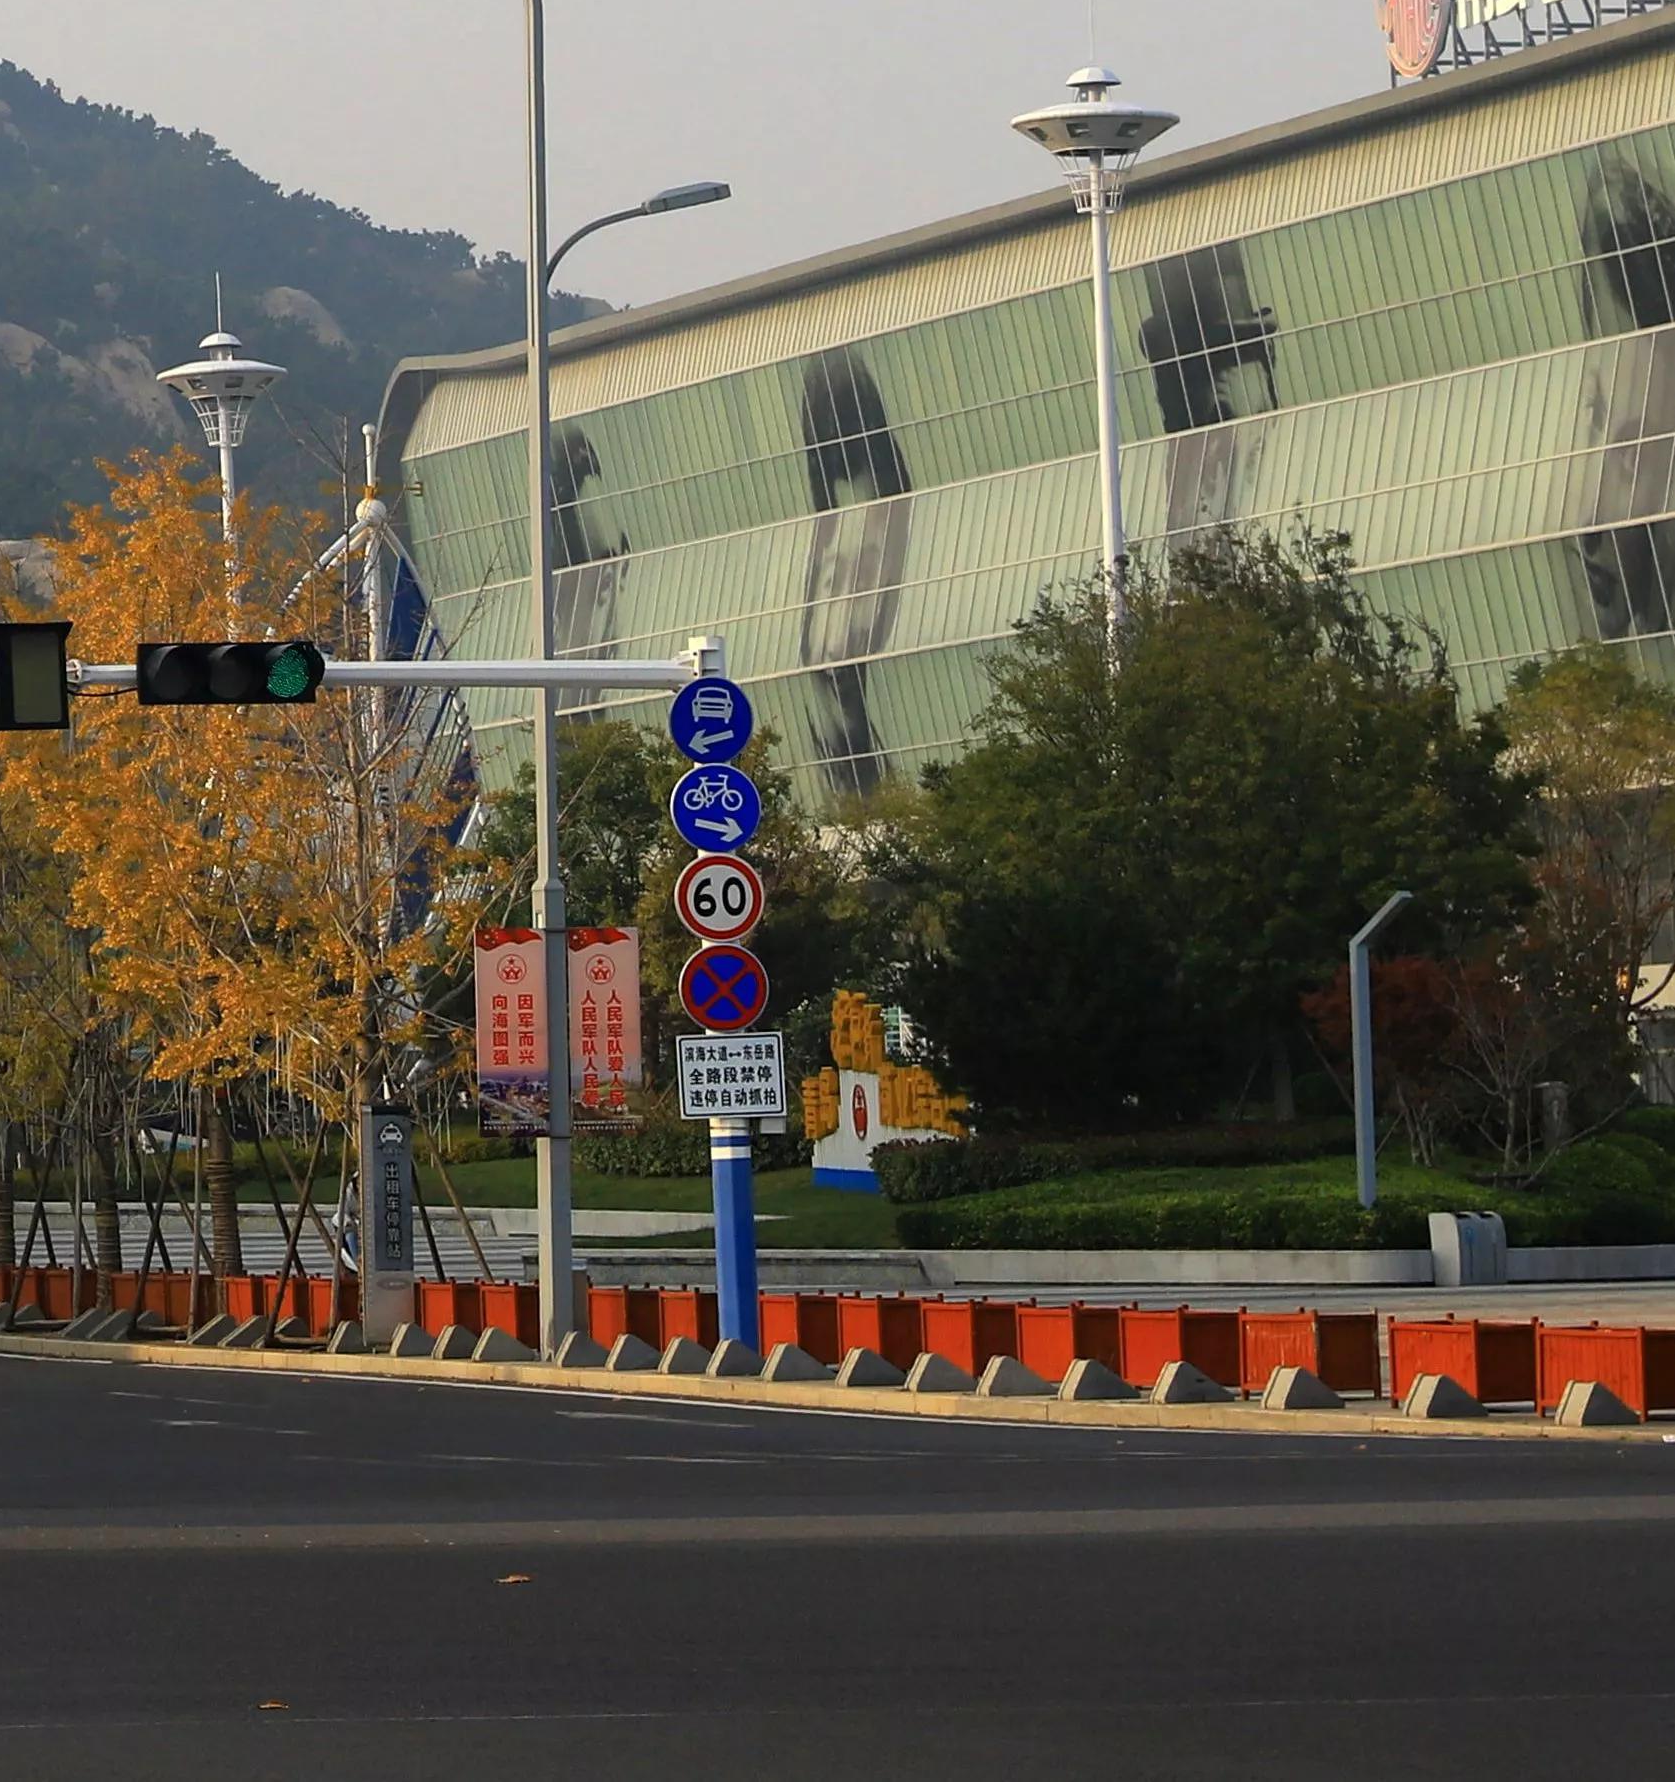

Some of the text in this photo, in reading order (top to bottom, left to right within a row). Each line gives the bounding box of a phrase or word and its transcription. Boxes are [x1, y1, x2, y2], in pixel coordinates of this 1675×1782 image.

[693, 876, 747, 918] 60
[492, 994, 509, 1066] 向海图强
[517, 994, 535, 1065] 因军而兴
[606, 989, 625, 1106] 人民军队爱人民
[684, 1044, 775, 1062] 滨海大道 东岳路
[690, 1065, 772, 1085] 全路段禁停
[690, 1087, 777, 1107] 违停自动抓拍
